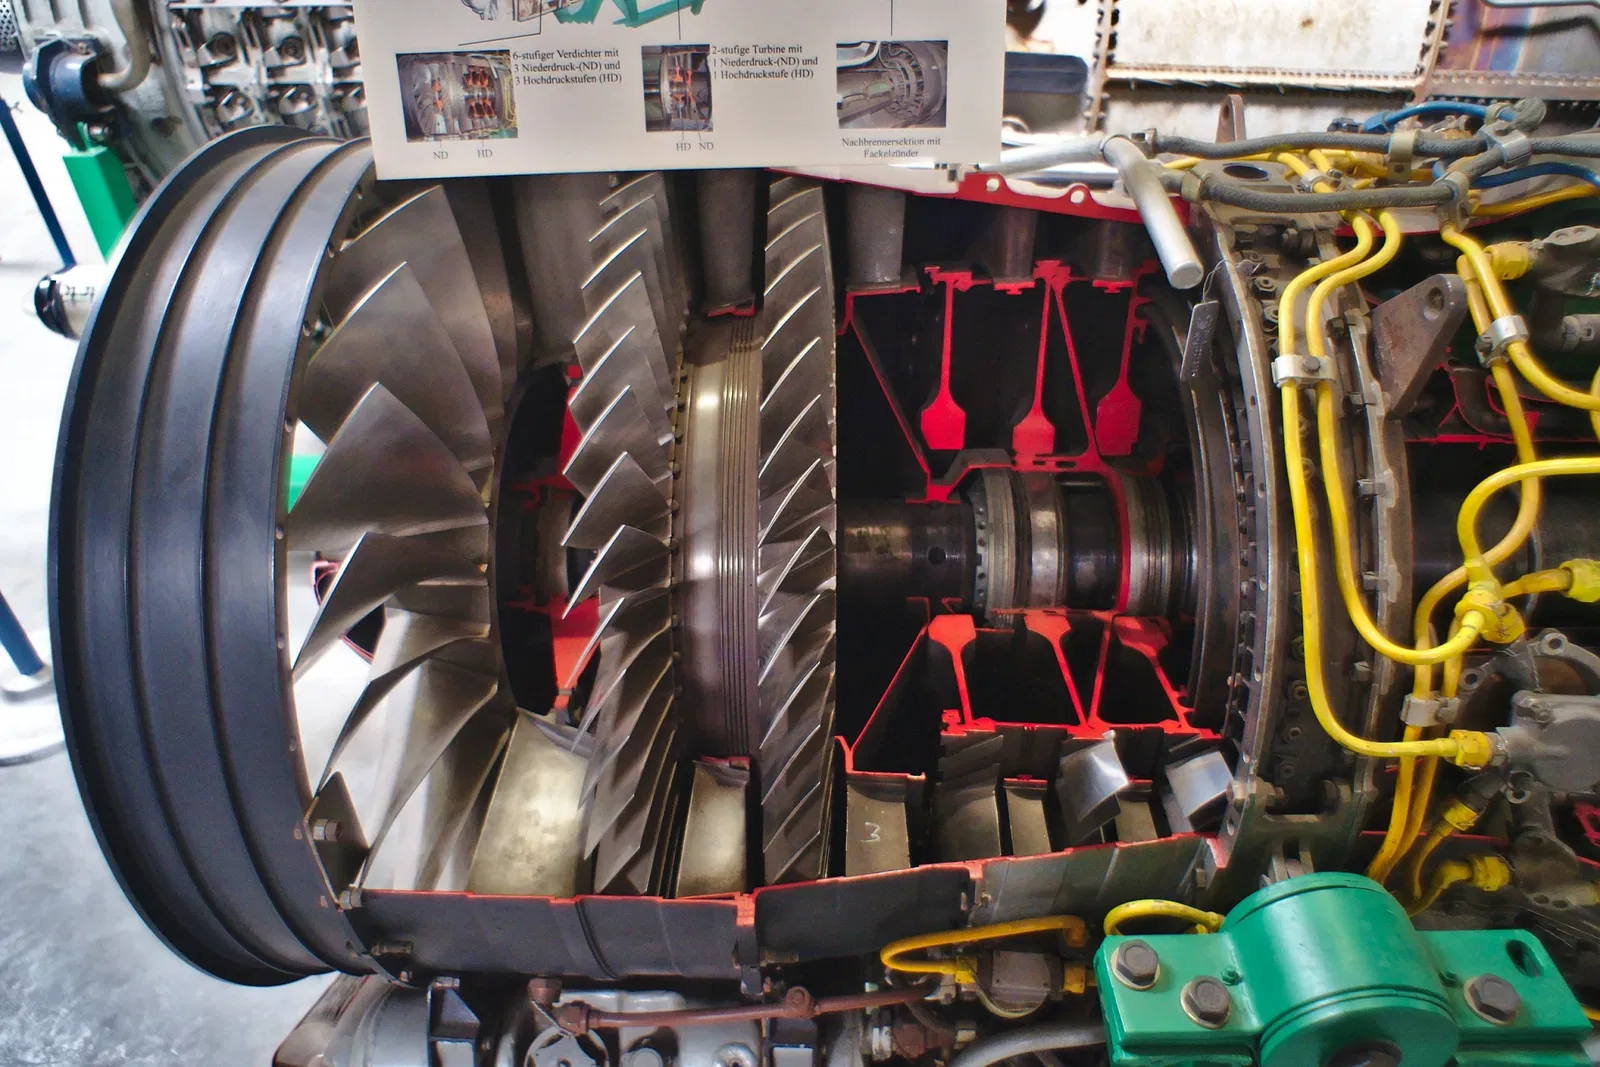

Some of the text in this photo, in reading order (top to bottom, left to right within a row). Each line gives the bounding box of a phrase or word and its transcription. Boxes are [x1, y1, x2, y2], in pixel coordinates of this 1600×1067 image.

[513, 48, 619, 61] 6-stufiger Verdichter mit
[712, 44, 802, 56] 2-stufige Turbine mit
[514, 61, 620, 73] 3 Niederdruck-(ND) und
[720, 57, 800, 67] Niederdruck-(ND)
[802, 57, 818, 66] und
[721, 69, 788, 79] Hochdruckstufe
[791, 68, 814, 79] (HD)
[516, 73, 622, 86] 3 Hochdruckstufen (HD)
[676, 142, 691, 151] HD
[699, 142, 714, 151] ND
[841, 137, 941, 147] Nachbrennersektion mit
[433, 151, 449, 159] ND
[477, 149, 493, 158] HD
[864, 149, 919, 158] Fackelzünder
[860, 821, 880, 842] 3
